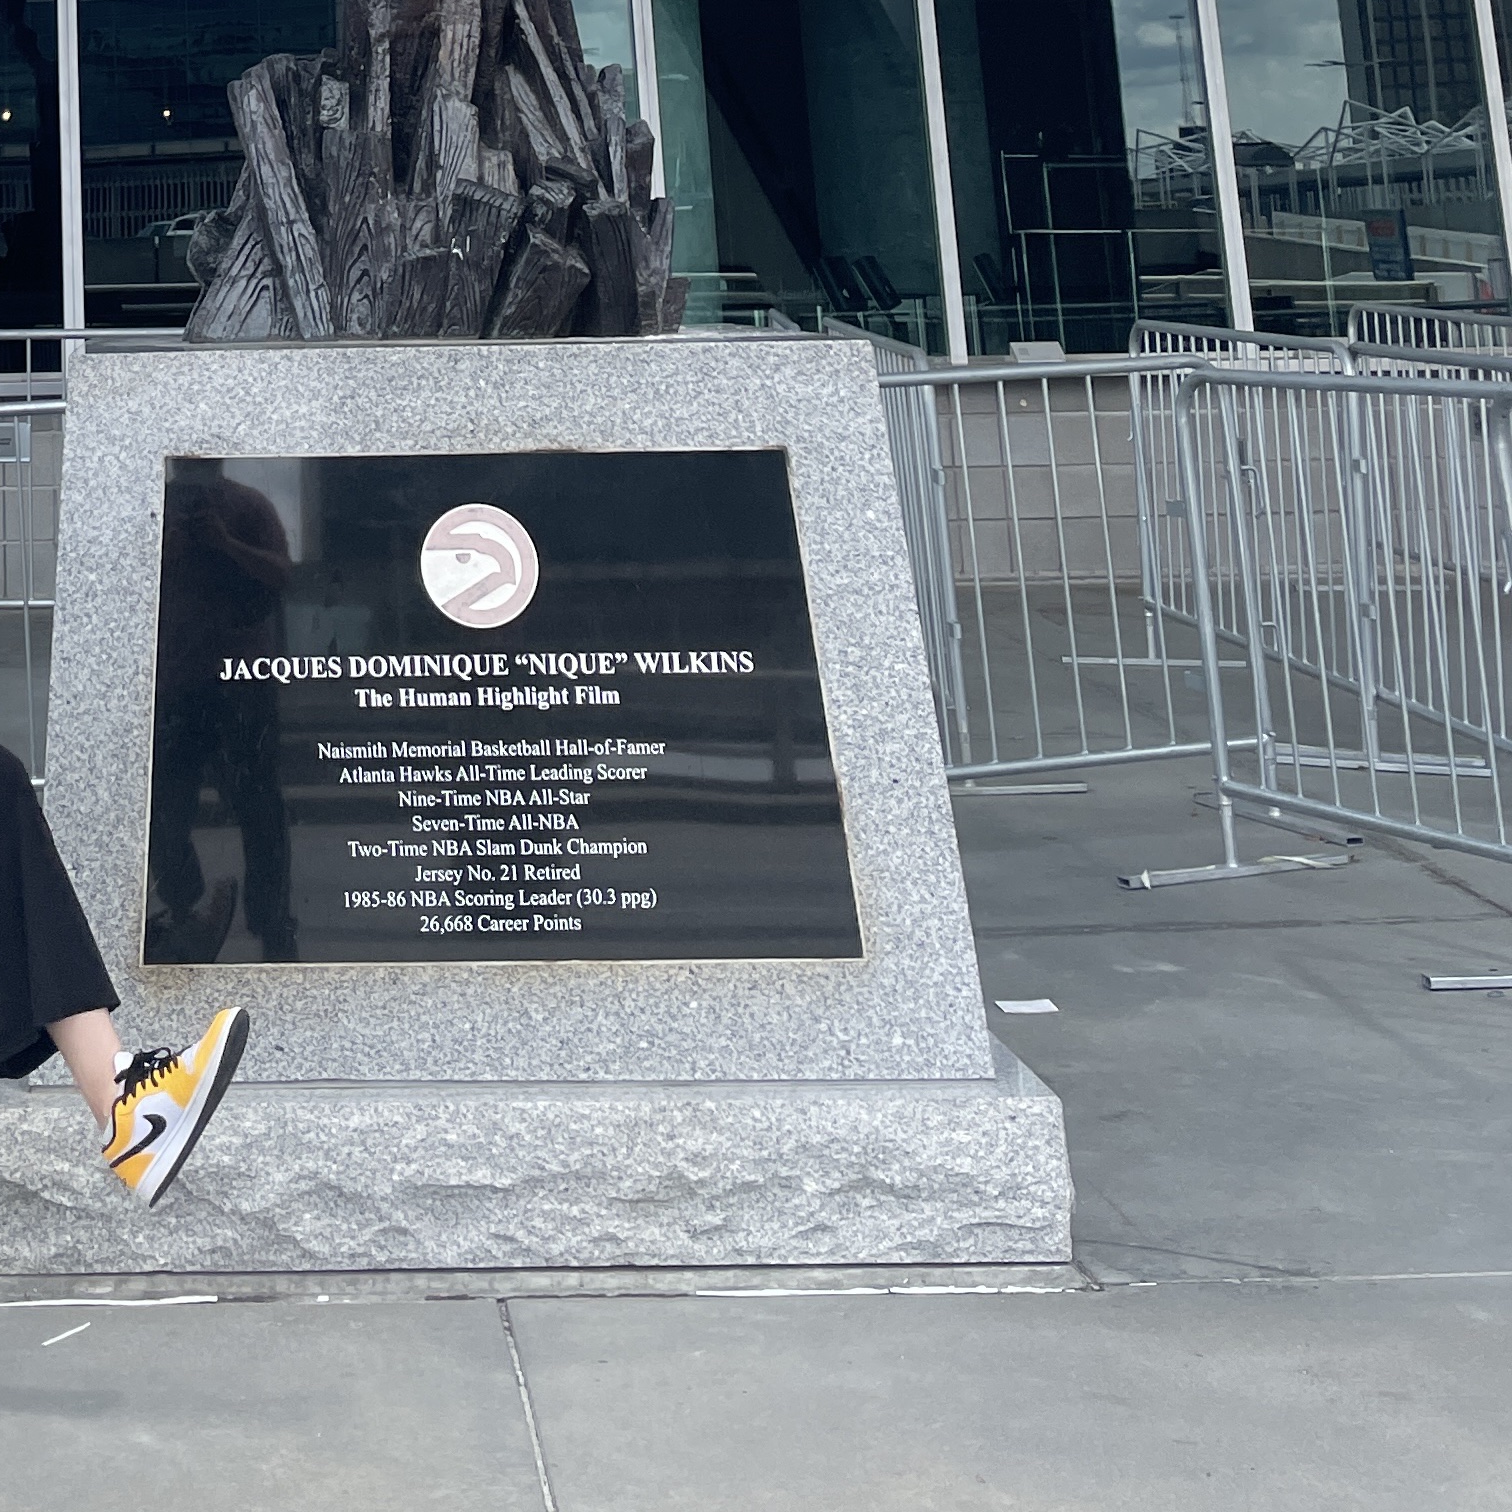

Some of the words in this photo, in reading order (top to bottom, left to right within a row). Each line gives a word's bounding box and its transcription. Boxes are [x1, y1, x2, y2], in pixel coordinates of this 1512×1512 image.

[219, 655, 343, 684] JACQUES
[347, 653, 510, 682] DOMINIQUE
[514, 651, 629, 680] “NIQUE”
[633, 650, 755, 675] WILKINS
[354, 688, 393, 708] The
[398, 687, 472, 708] Human
[476, 685, 570, 711] Highlight
[573, 685, 621, 705] Film
[317, 741, 388, 761] Naismith
[391, 739, 467, 759] Memorial
[470, 738, 552, 757] Basketball
[554, 738, 666, 757] Hall-of-Famer
[339, 765, 396, 785] Atlanta
[399, 765, 453, 783] Hawks
[455, 763, 526, 782] All-Time
[529, 762, 594, 785] Leading
[596, 763, 648, 781] Scorer
[397, 789, 482, 808] Nine-Time
[484, 788, 527, 807] NBA
[528, 788, 591, 806] All-Star
[411, 813, 505, 832] Seven-Time
[507, 813, 580, 831] All-NBA
[346, 839, 428, 858] Two-Time
[431, 839, 474, 857] NBA
[475, 838, 516, 856] Slam
[519, 837, 564, 856] Dunk
[566, 836, 648, 859] Champion
[414, 865, 464, 886] Jersey
[465, 864, 496, 882] No.
[499, 864, 518, 882] 21
[523, 863, 581, 881] Retired
[343, 890, 407, 909] 1985-86
[409, 890, 452, 908] NBA
[454, 888, 516, 911] Scoring
[518, 888, 573, 907] Leader
[576, 887, 617, 909] (30.3
[620, 887, 658, 910] ppg)
[419, 914, 474, 935] 26,668
[477, 914, 530, 932] Career
[532, 913, 582, 932] Points
